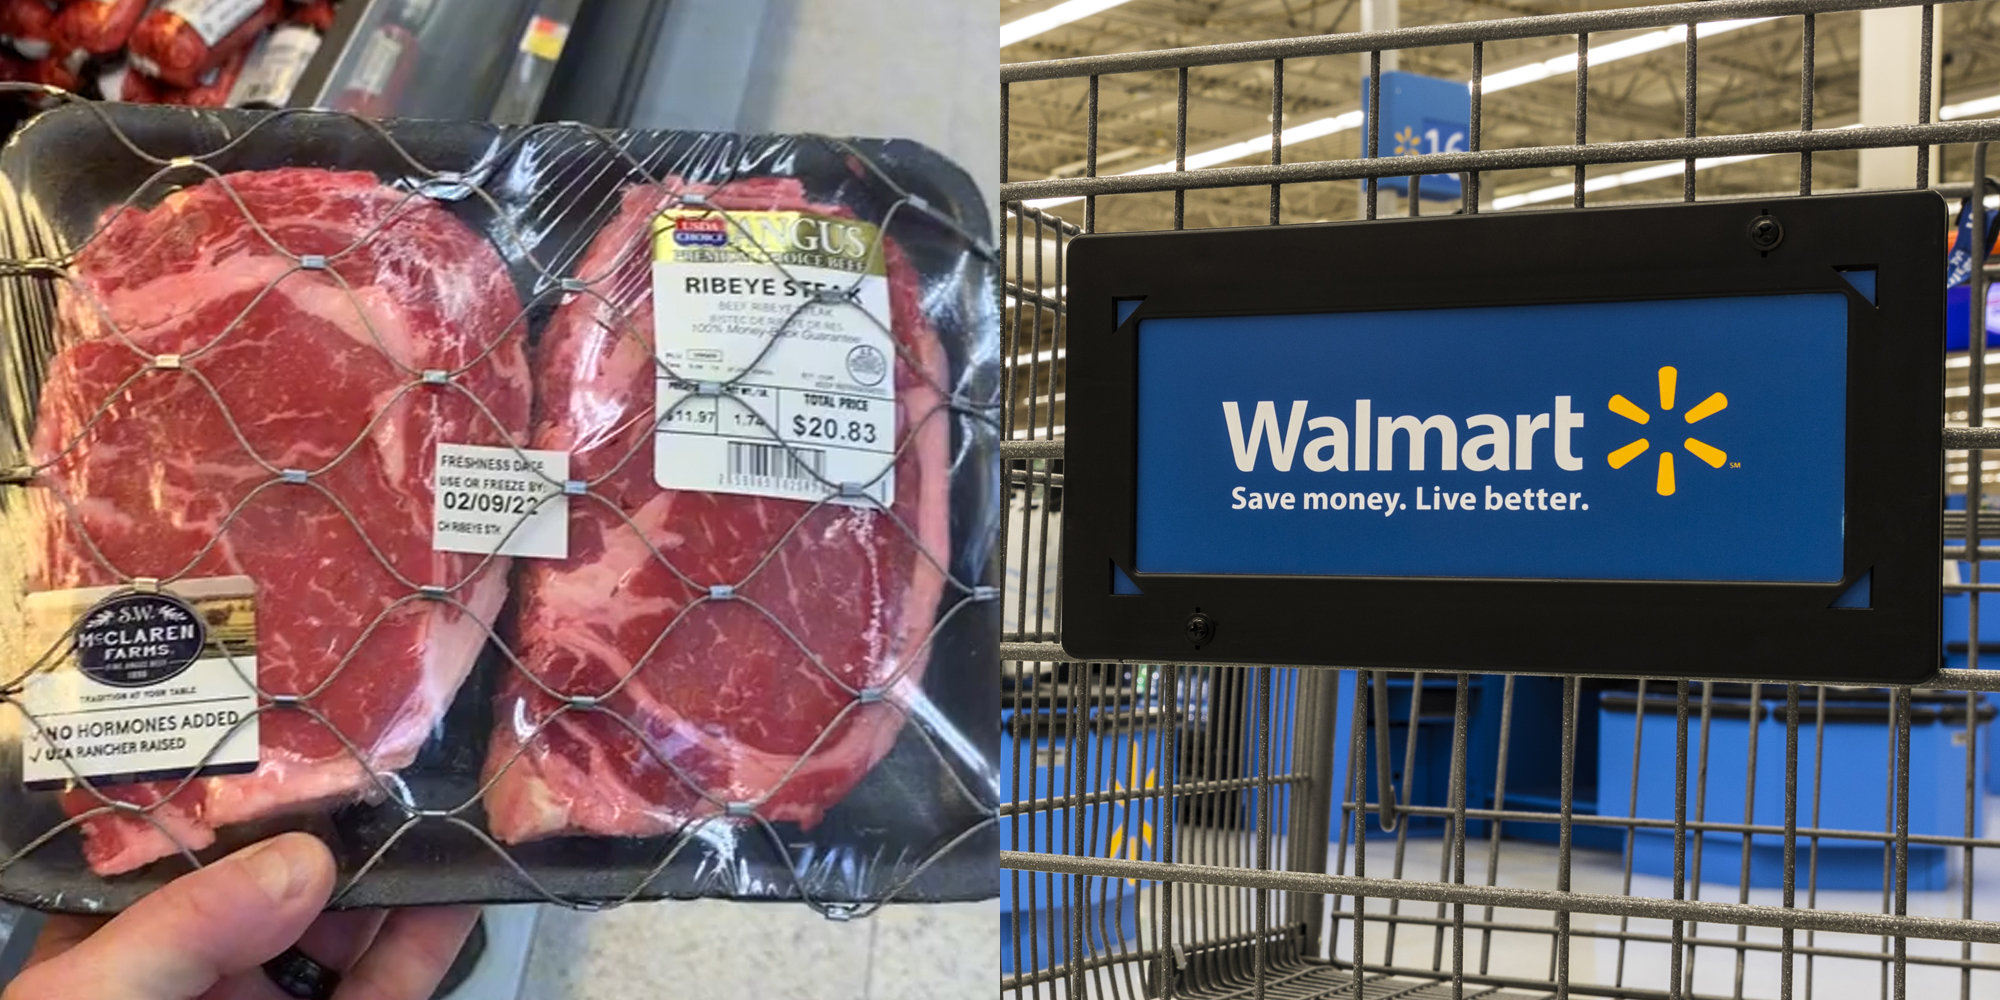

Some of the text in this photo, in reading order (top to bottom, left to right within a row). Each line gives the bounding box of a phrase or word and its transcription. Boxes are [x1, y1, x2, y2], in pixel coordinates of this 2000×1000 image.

[1424, 128, 1465, 181] 16
[680, 219, 722, 232] USDA
[674, 232, 726, 243] CHOICE
[732, 216, 868, 258] ANGUS
[685, 276, 776, 296] RIBEYE
[803, 393, 869, 413] TOTAL PRICE
[792, 414, 877, 444] $20.83
[1222, 395, 1584, 472] Walmart
[441, 455, 511, 472] FRESHNESS
[1729, 461, 1742, 469] SM
[439, 475, 462, 488] USE
[463, 477, 481, 488] OR
[483, 478, 526, 491] FREEZE
[443, 491, 539, 516] 02/09/22
[1231, 485, 1589, 517] Save money. Live better.
[452, 521, 484, 534] RIBEYE
[117, 604, 156, 624] S.W.
[46, 710, 240, 741] NO HORMONES ADDED
[77, 741, 138, 759] RANCHER
[139, 737, 187, 754] RAISED
